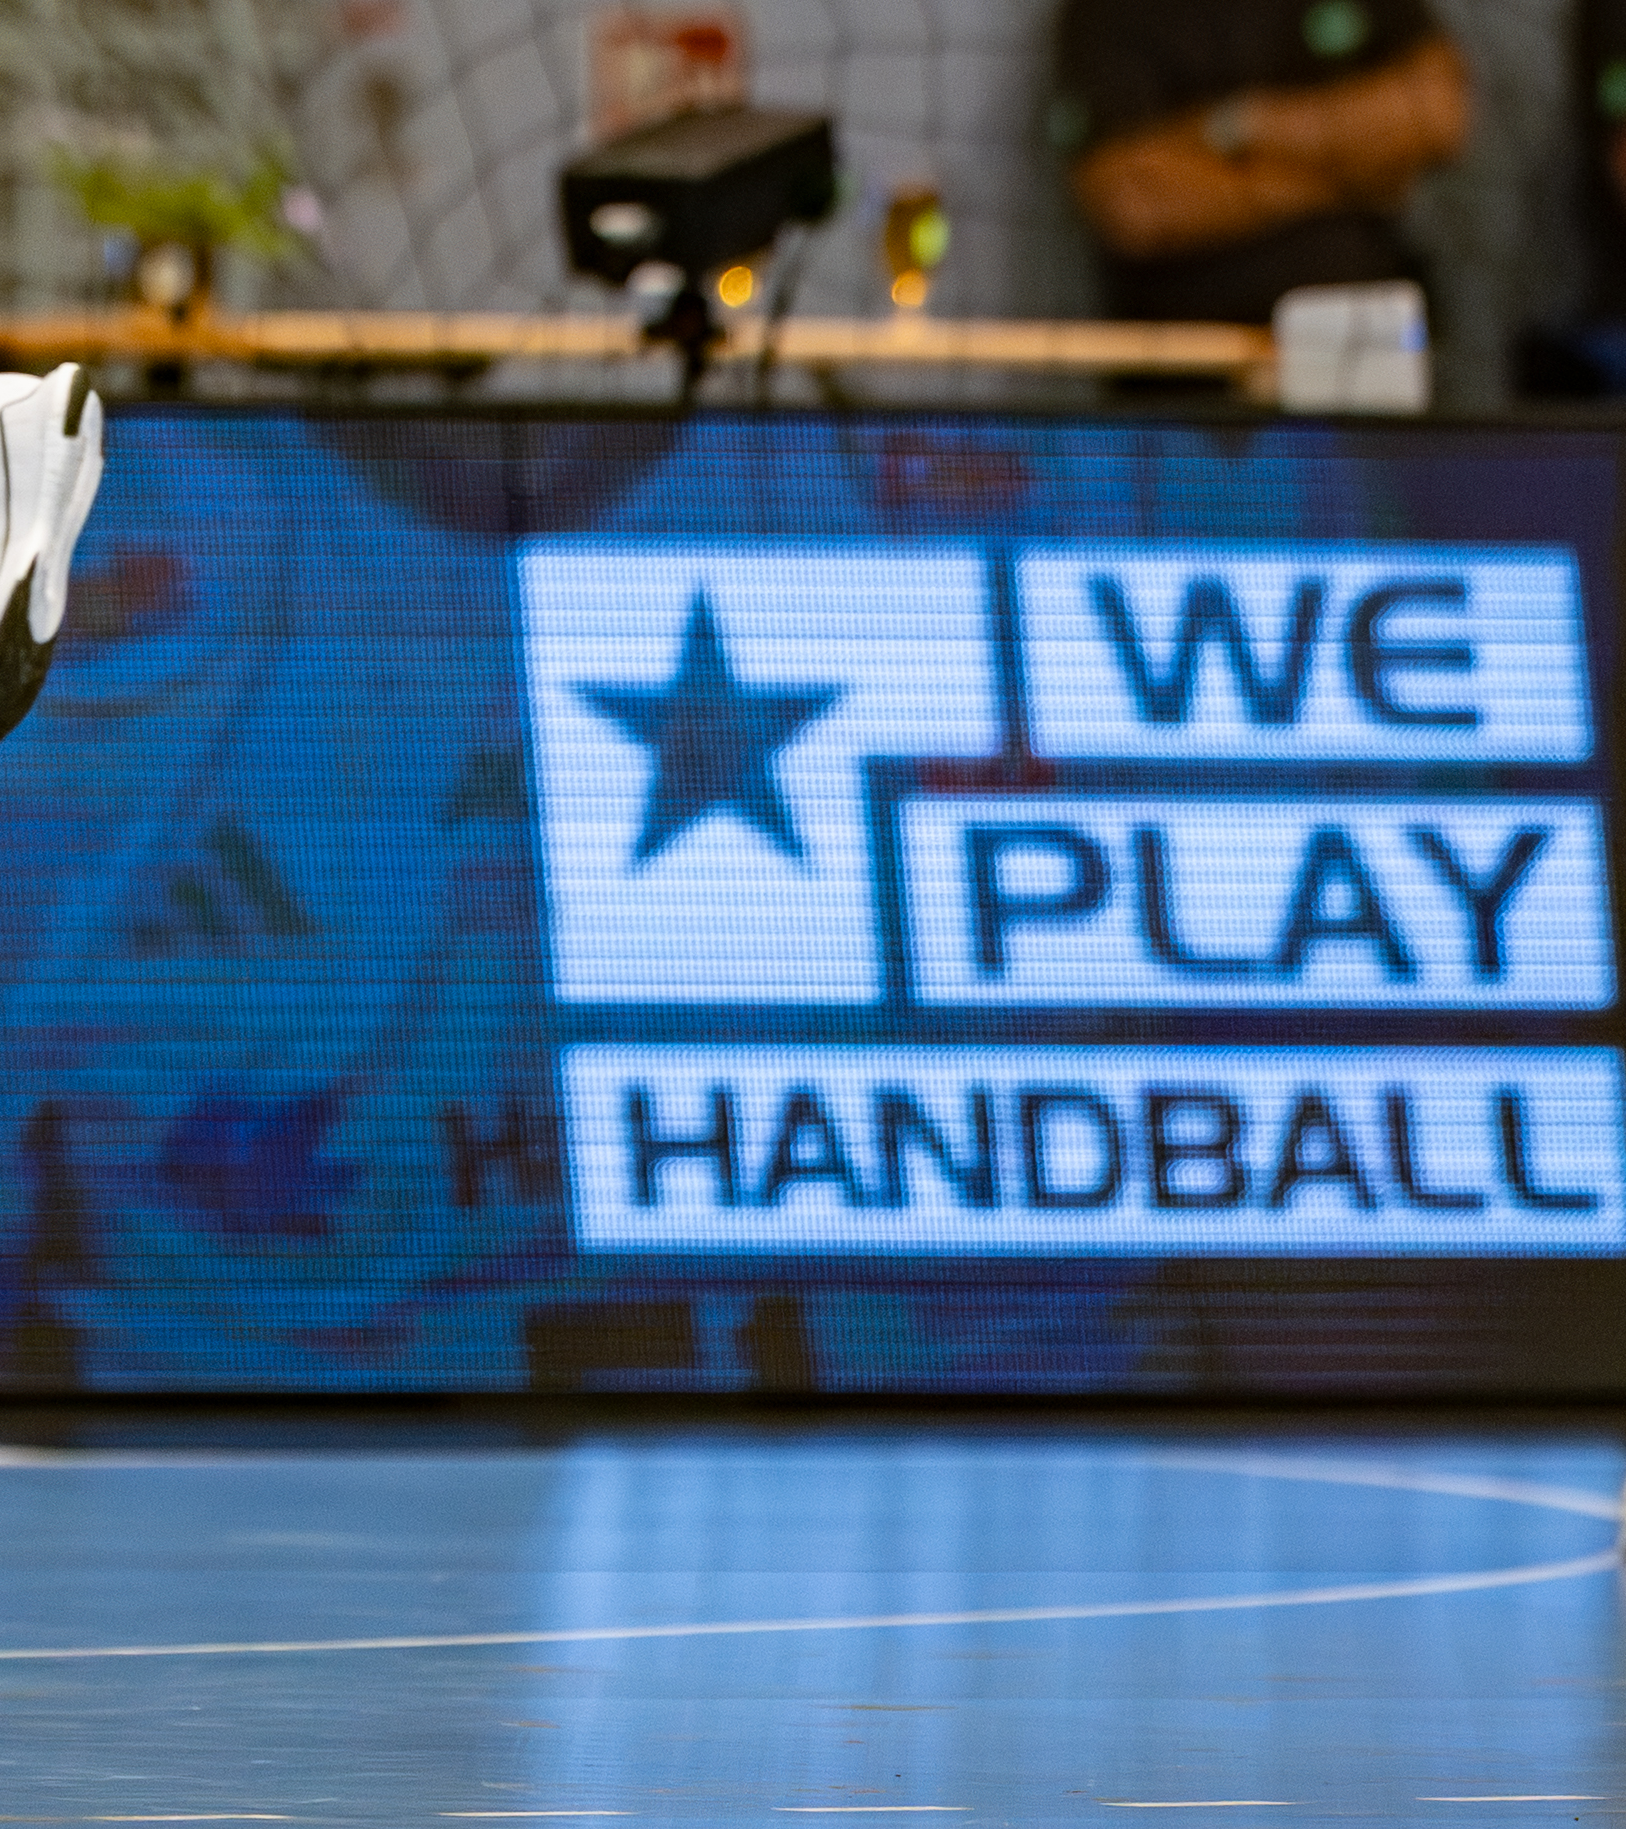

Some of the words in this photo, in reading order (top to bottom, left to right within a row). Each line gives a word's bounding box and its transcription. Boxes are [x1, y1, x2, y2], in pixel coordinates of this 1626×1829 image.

[1085, 573, 1480, 726] WE
[964, 821, 1555, 983] PLAY
[624, 1086, 1602, 1213] HANDBALL
